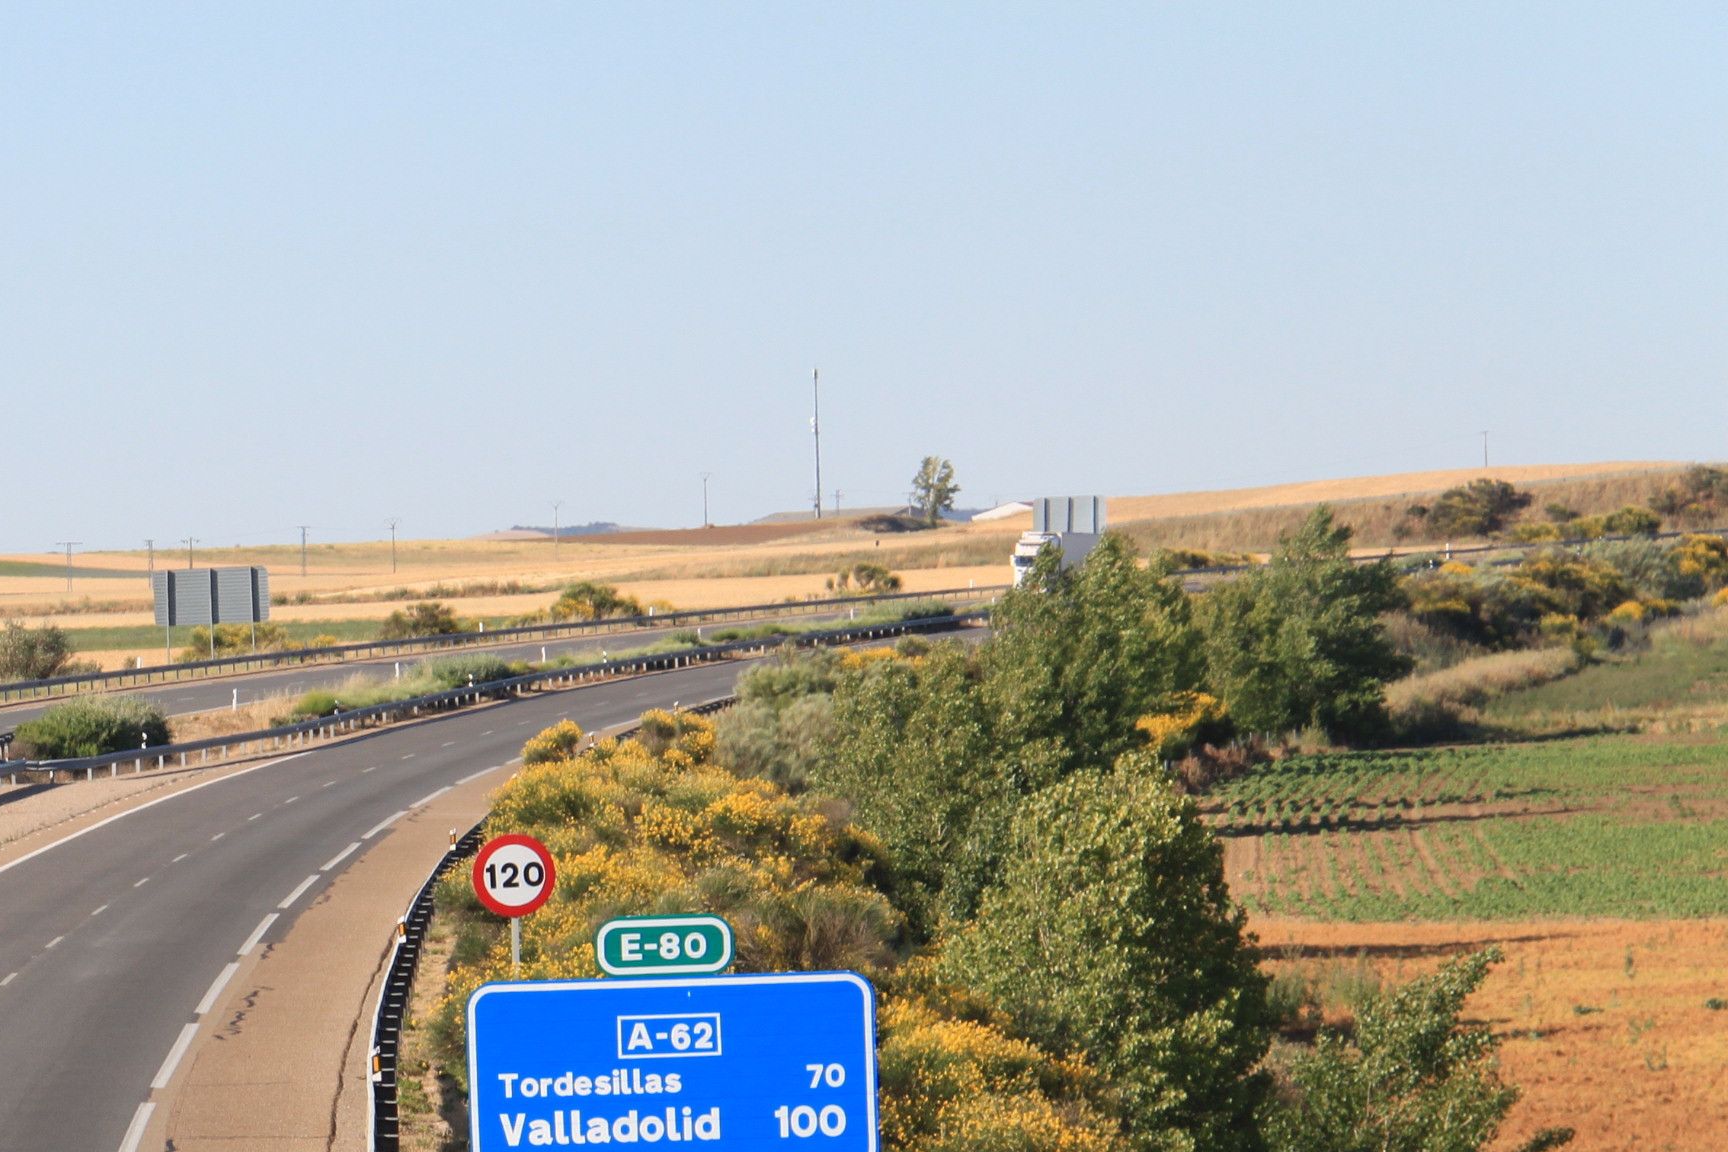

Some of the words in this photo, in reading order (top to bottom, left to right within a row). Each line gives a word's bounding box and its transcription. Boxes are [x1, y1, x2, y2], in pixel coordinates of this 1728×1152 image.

[484, 861, 545, 889] 120
[621, 932, 707, 962] E-80
[627, 1022, 714, 1051] A-62
[498, 1068, 682, 1098] Tordesillas
[806, 1063, 846, 1089] 70
[499, 1106, 721, 1147] Valladolid
[774, 1104, 847, 1139] 100
